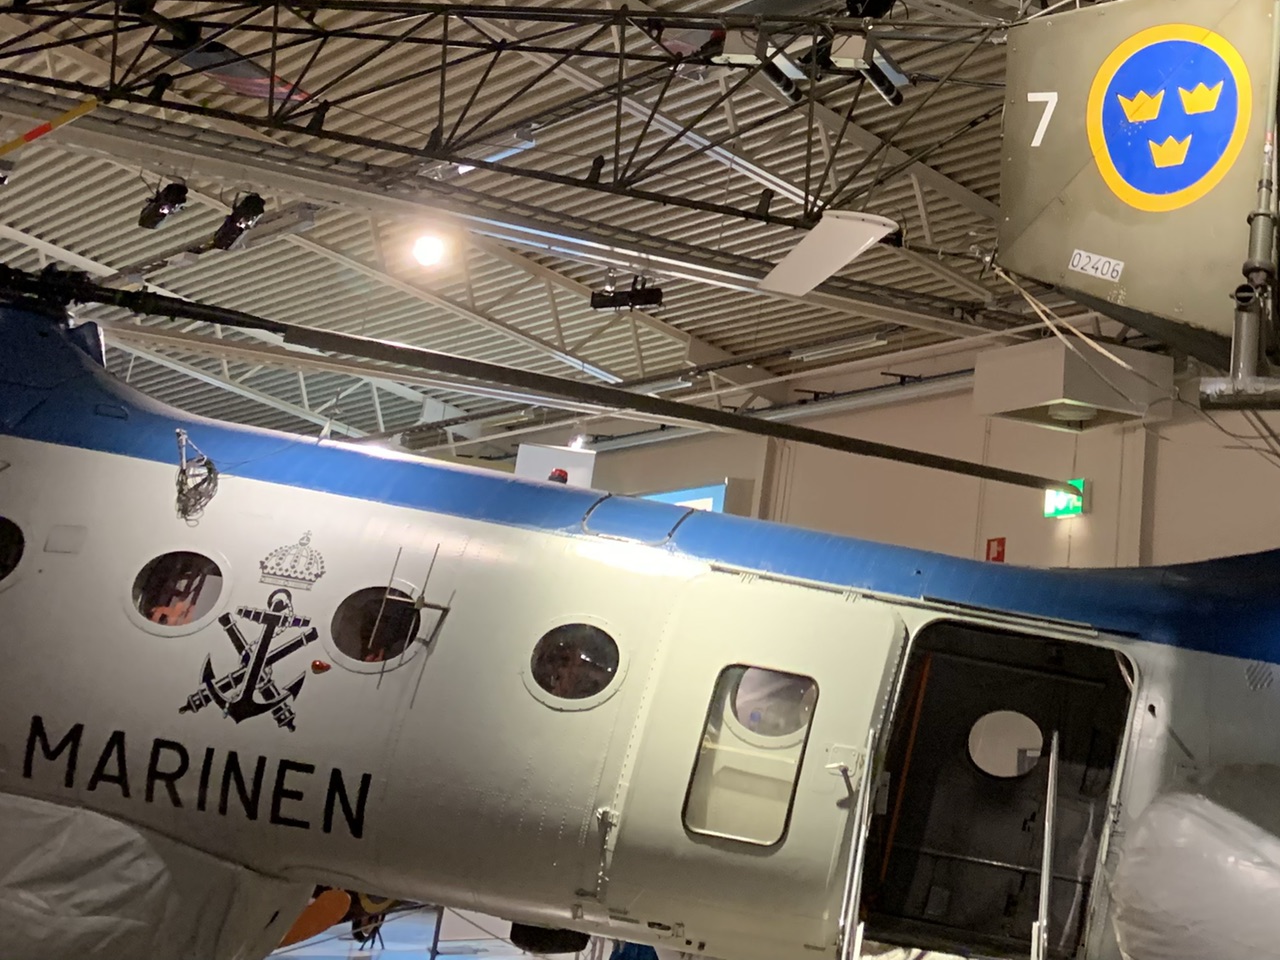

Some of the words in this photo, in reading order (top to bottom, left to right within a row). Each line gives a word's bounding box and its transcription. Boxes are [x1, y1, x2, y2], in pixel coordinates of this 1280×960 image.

[1027, 92, 1058, 147] 7
[1071, 251, 1121, 280] 02406
[23, 714, 372, 839] MARINEN
